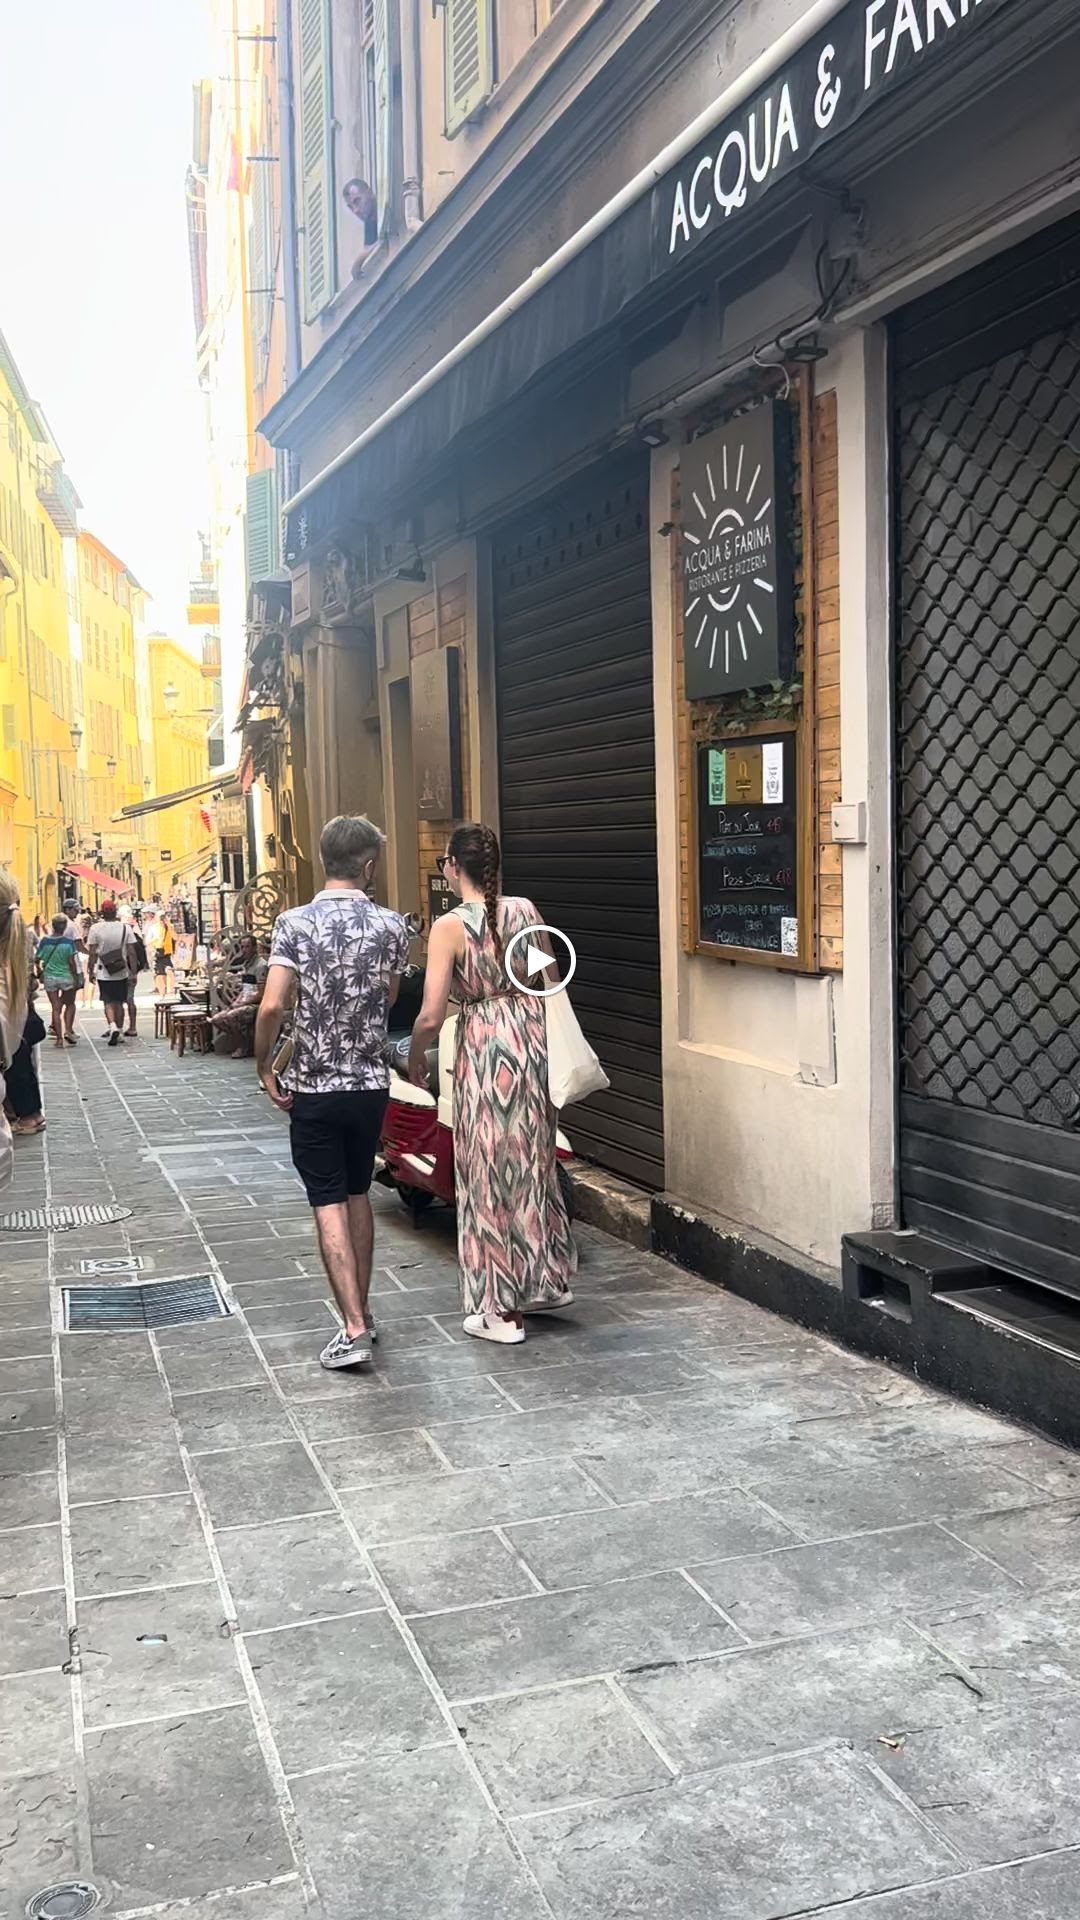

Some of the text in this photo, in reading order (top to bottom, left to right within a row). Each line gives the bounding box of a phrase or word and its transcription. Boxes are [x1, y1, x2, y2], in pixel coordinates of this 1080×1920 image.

[668, 83, 799, 255] ACQUA
[813, 43, 841, 129] &
[683, 524, 772, 575] ACQUA & FARINA
[688, 553, 768, 591] RISTORANTE E PIZZERIA
